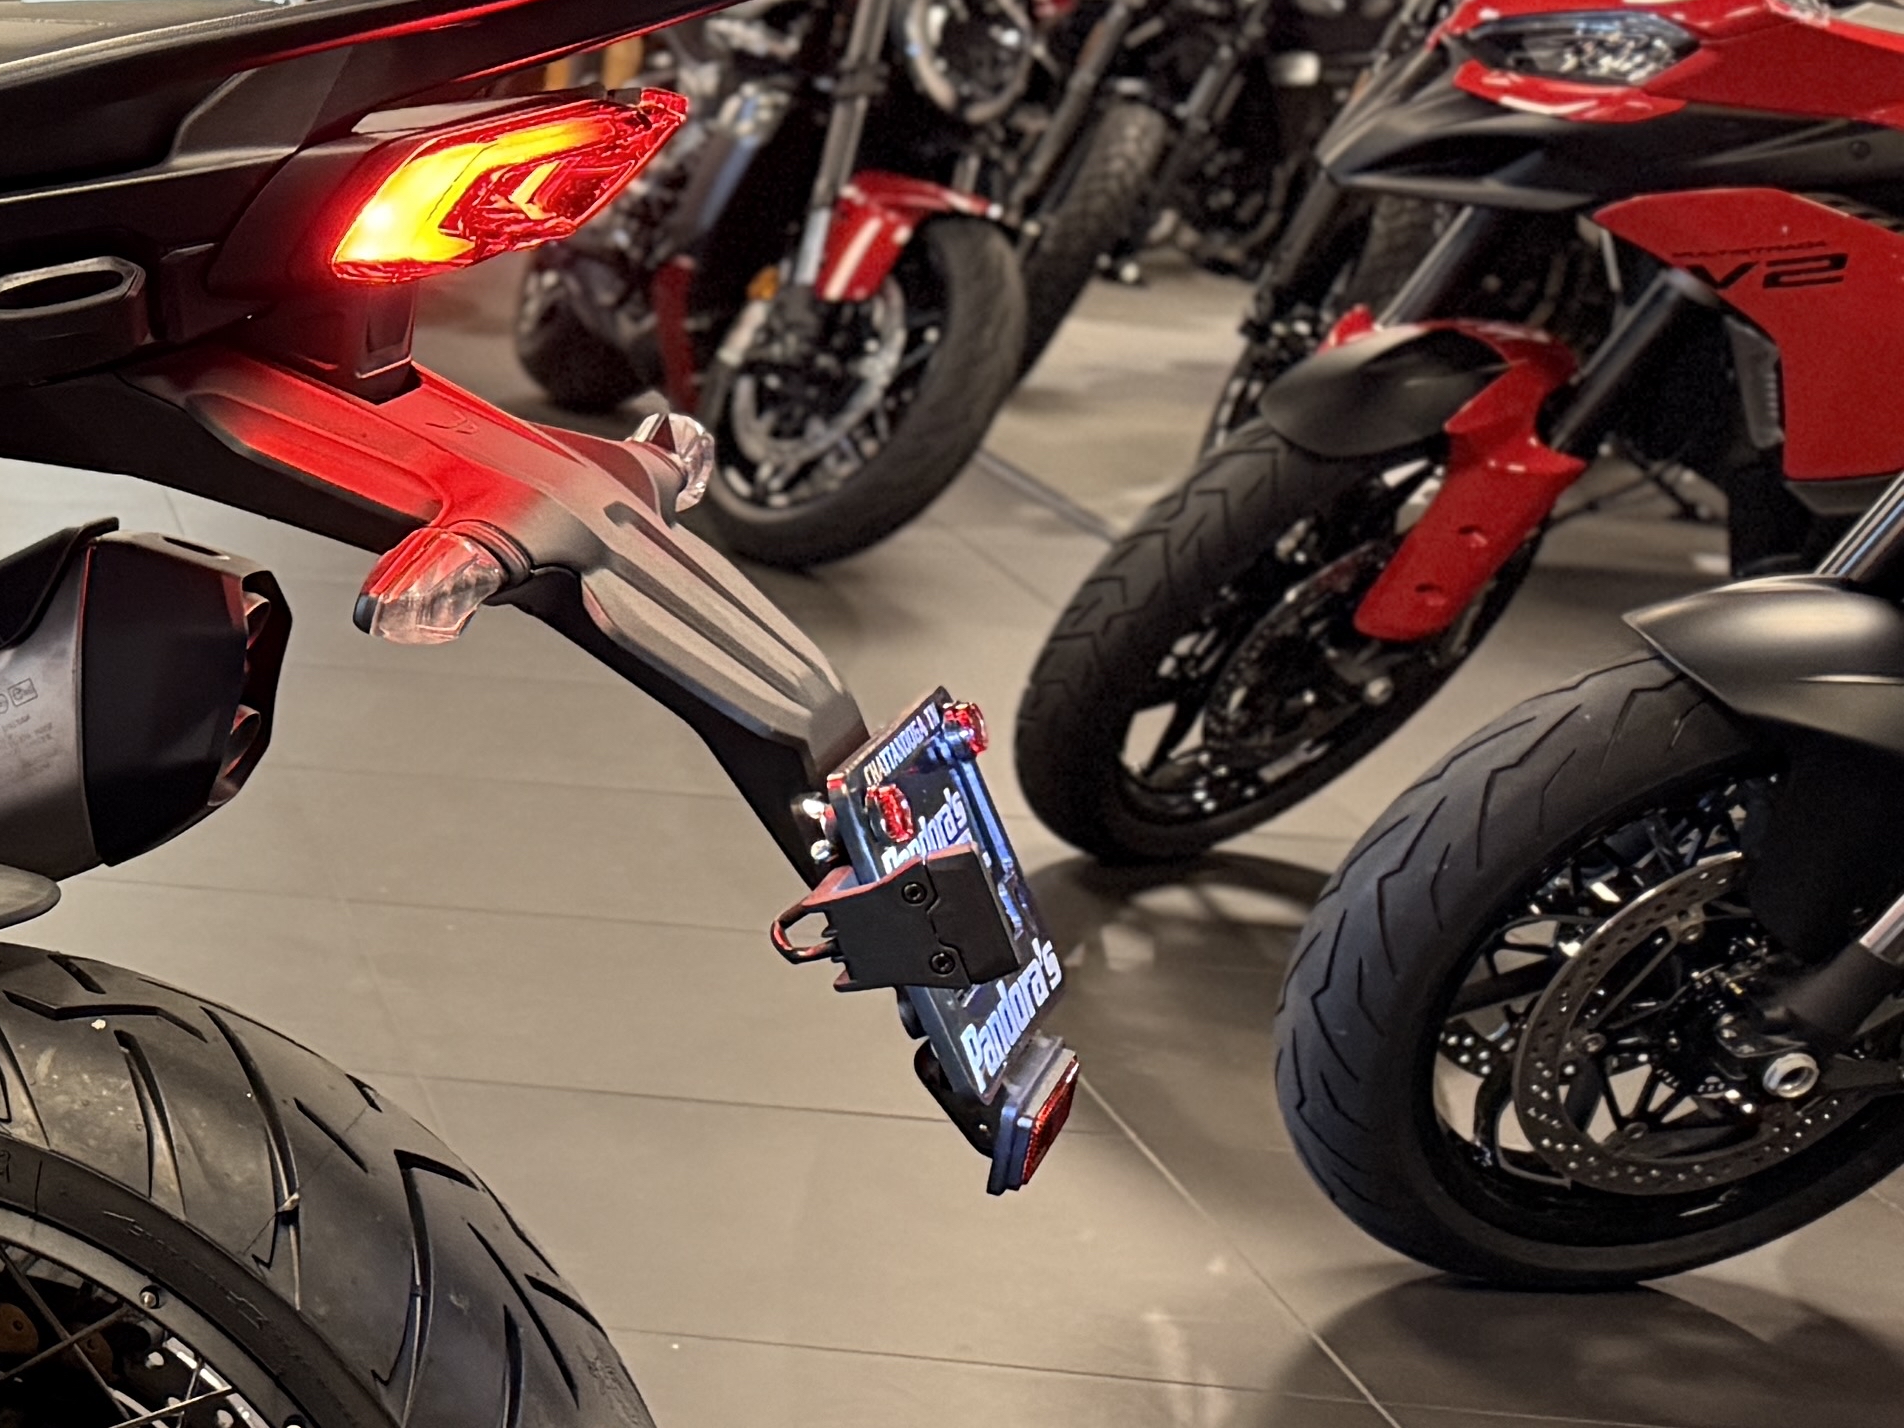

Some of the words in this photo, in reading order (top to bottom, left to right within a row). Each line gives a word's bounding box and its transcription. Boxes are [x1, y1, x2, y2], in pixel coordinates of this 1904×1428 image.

[1685, 252, 1848, 290] V2
[863, 715, 929, 787] CHATTANOOGA
[960, 937, 1063, 1094] Pandora's
